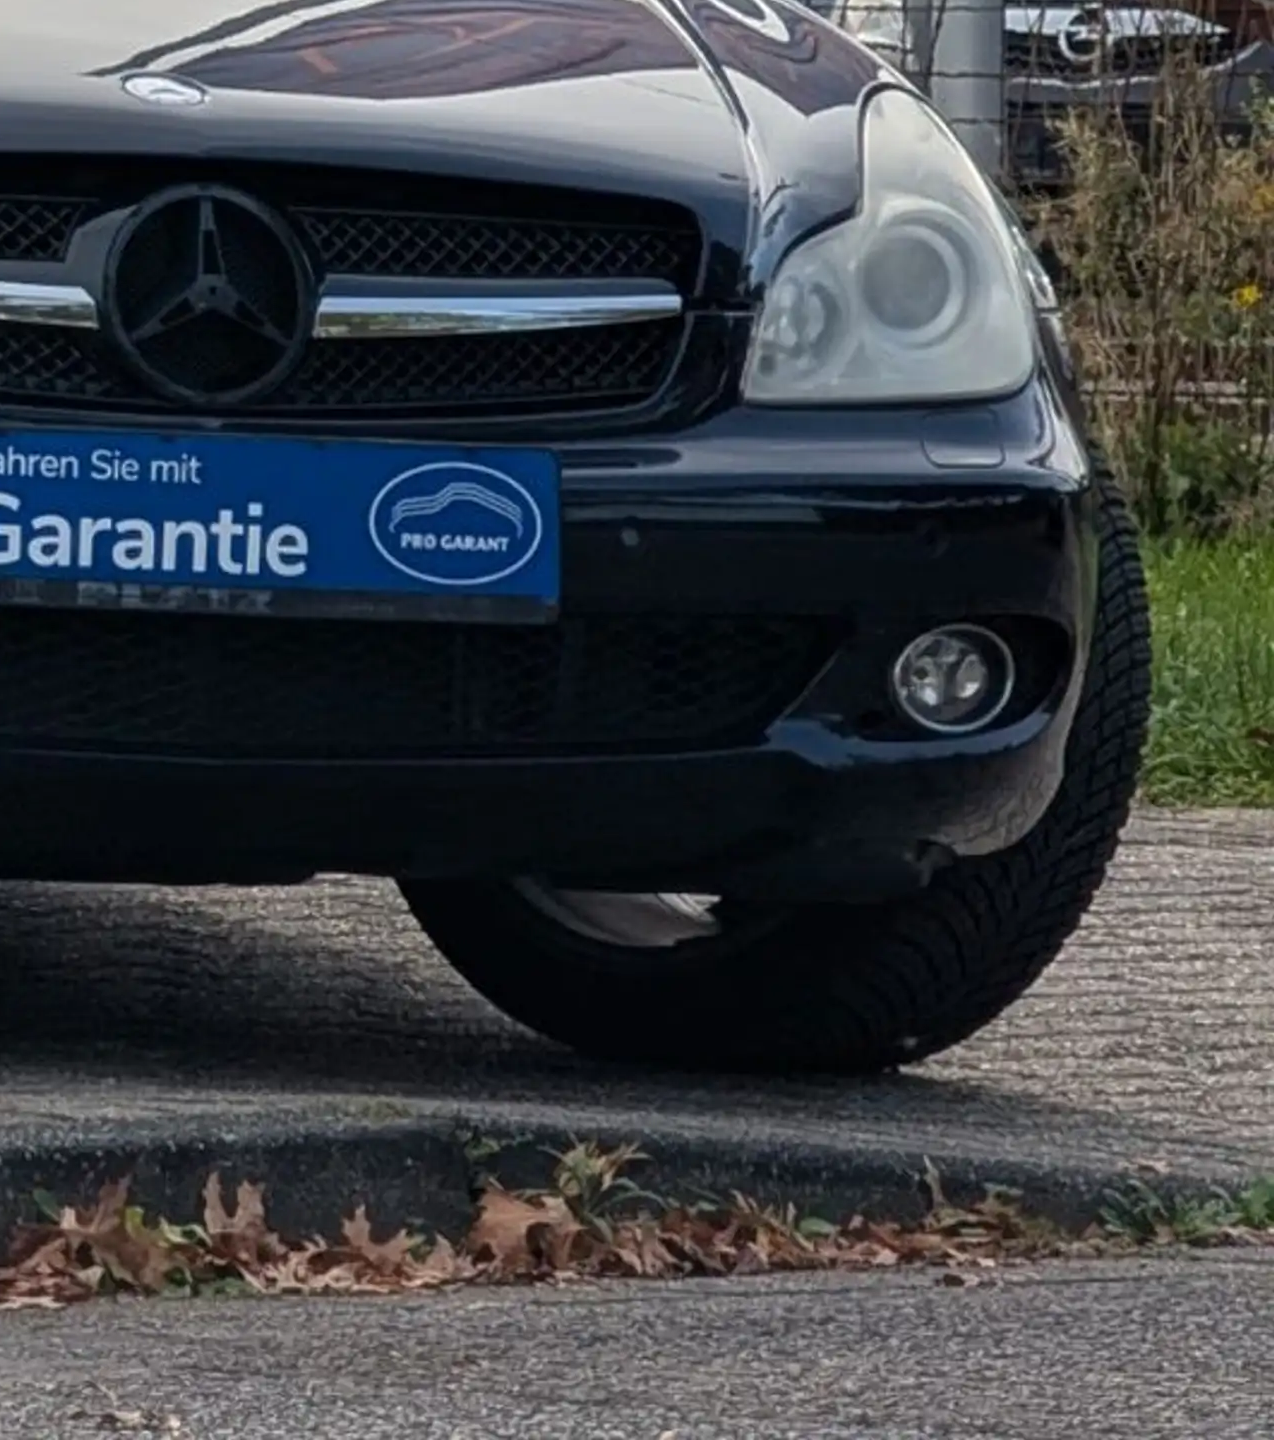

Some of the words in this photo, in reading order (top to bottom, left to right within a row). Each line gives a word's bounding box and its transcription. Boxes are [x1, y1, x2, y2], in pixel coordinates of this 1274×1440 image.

[89, 448, 140, 482] Sie
[150, 453, 202, 485] mit
[400, 532, 438, 550] PRO
[439, 533, 511, 552] GARANT
